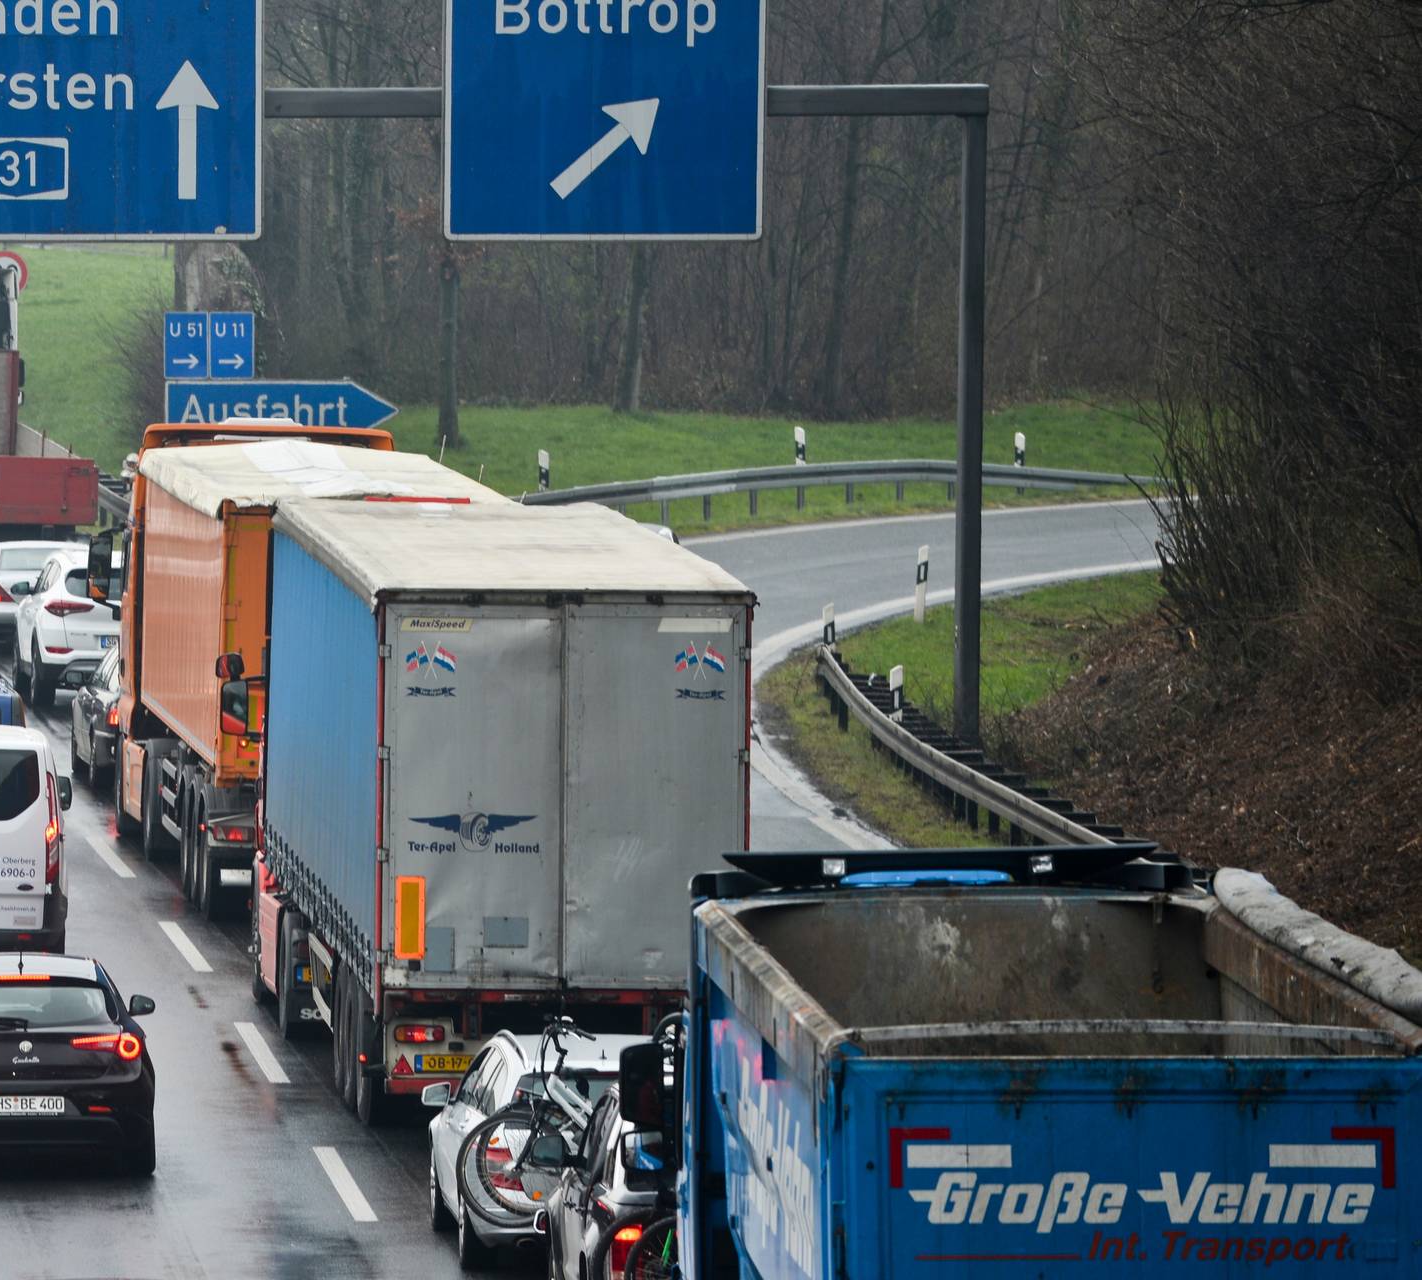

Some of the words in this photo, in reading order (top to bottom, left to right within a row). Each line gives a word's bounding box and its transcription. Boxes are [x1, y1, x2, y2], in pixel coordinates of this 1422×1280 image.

[495, 0, 717, 48] Bottrop
[0, 150, 37, 187] 31
[170, 323, 181, 337] U
[187, 322, 203, 337] 51
[215, 323, 226, 337] U
[232, 322, 245, 337] 11
[180, 394, 348, 426] Ausfahrt
[410, 618, 466, 630] MaxiSpeed
[408, 841, 456, 854] Ter-Apel
[495, 843, 540, 854] Holland
[2, 856, 36, 866] Oberberg
[20, 1097, 36, 1110] BE
[40, 1097, 63, 1111] 400
[908, 1171, 1129, 1234] Große
[1136, 1171, 1376, 1225] Vehne
[1087, 1230, 1147, 1261] Int.
